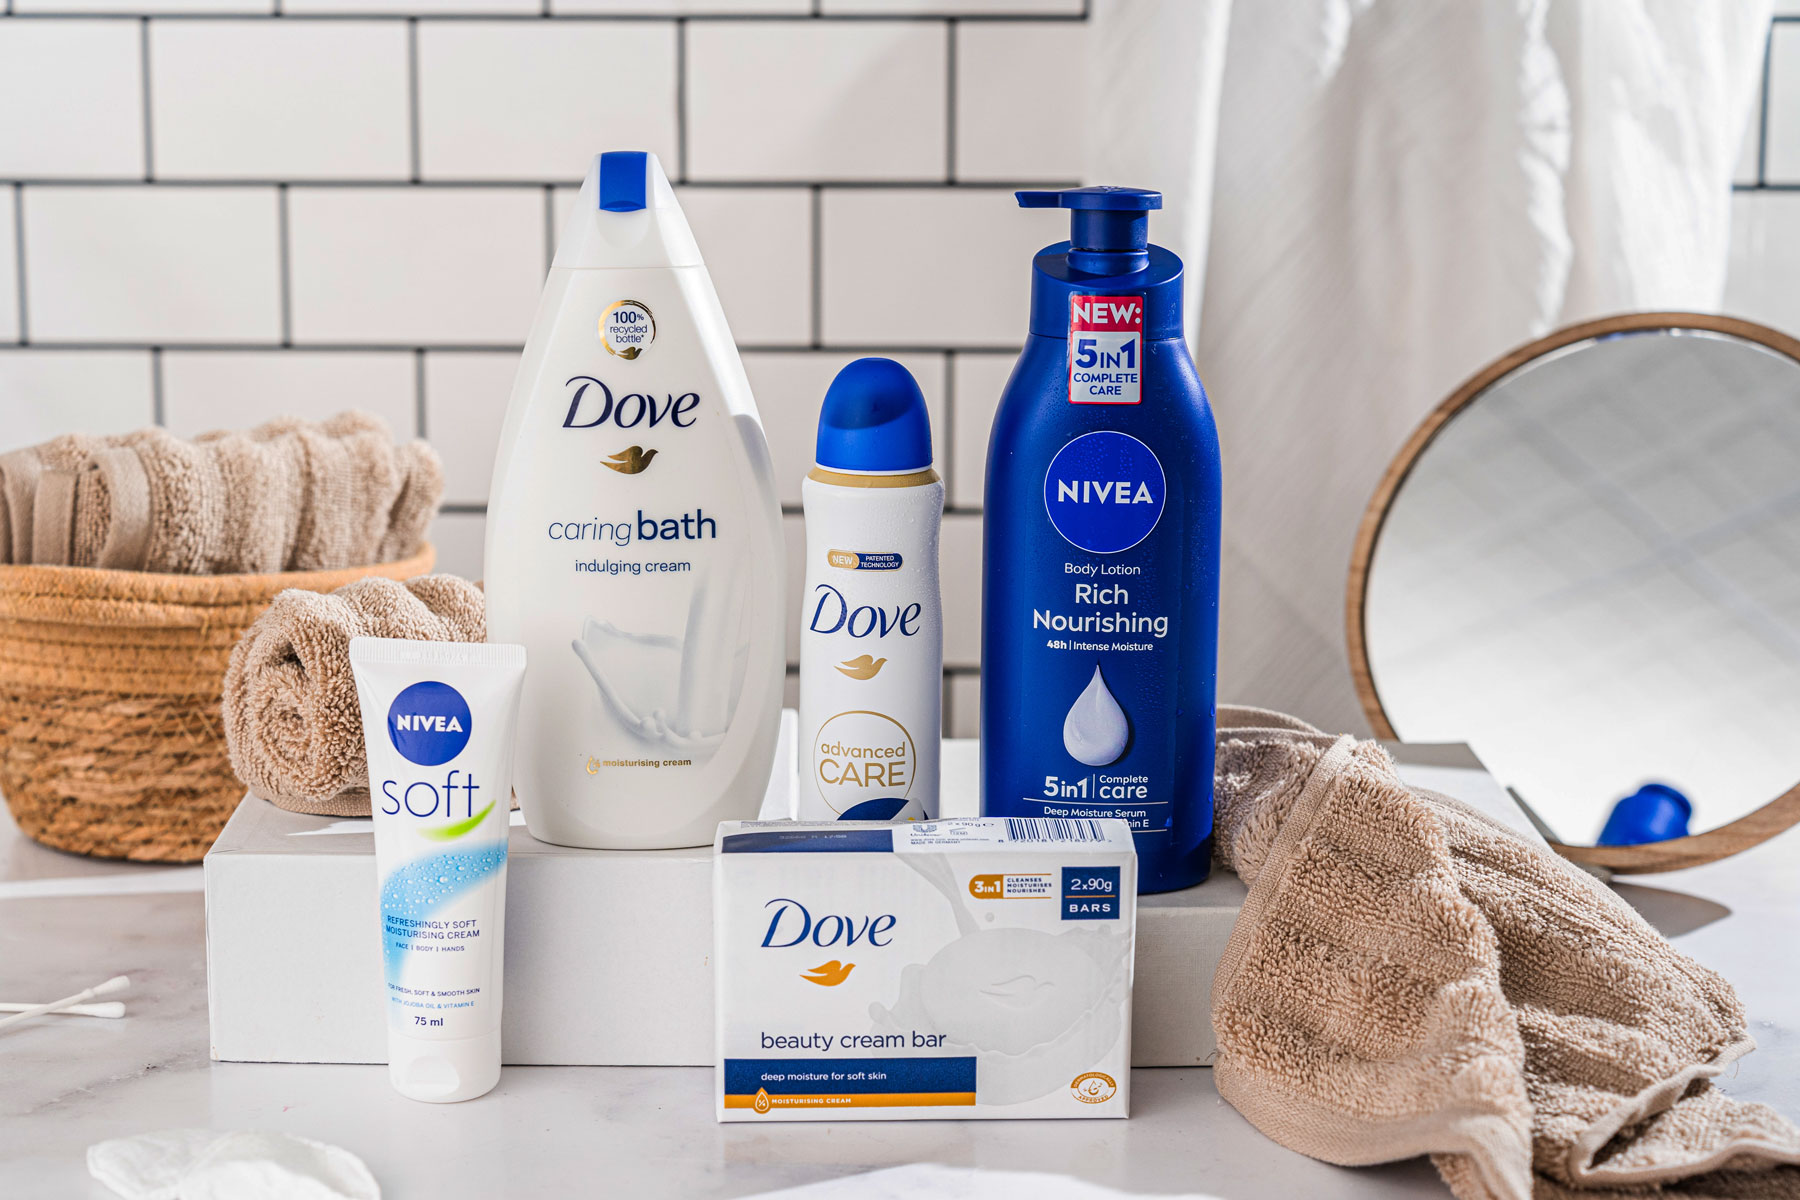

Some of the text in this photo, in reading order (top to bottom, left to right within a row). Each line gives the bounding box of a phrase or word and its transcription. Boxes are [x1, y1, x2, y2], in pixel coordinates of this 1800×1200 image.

[613, 311, 644, 324] 100%
[1073, 302, 1141, 325] NEW:
[610, 324, 648, 334] recycled
[1073, 373, 1138, 383] COMPLETE
[1089, 385, 1122, 396] CARE
[562, 375, 700, 428] Dove
[1058, 479, 1153, 504] NIVEA
[831, 554, 853, 565] NEW
[575, 559, 691, 575] indulging cream
[1064, 563, 1141, 577] Body Lotion
[1075, 583, 1128, 605] Rich
[810, 584, 921, 639] Dove
[1033, 608, 1168, 638] Nourishing
[1047, 640, 1153, 651] 48h Intense Moisture
[396, 713, 463, 734] NIVEA
[821, 741, 906, 759] advanced
[602, 758, 660, 768] moisturising
[819, 758, 906, 788] CARE
[1043, 776, 1148, 799] 5in1 care
[1099, 775, 1149, 786] Complete
[381, 770, 480, 818] soft
[1044, 806, 1147, 818] Deep Moisture Serum
[974, 880, 1001, 893] 3IN1
[1069, 903, 1111, 913] BARS
[387, 915, 477, 929] REFRESHINGLY SOFT
[760, 898, 896, 949] Dove
[386, 924, 480, 939] MOISTURISING CREAM
[466, 987, 480, 995] SKIN
[414, 1016, 444, 1026] 75 ml
[761, 1030, 946, 1051] beauty cream bar
[761, 1072, 887, 1082] deep moisture for soft skin
